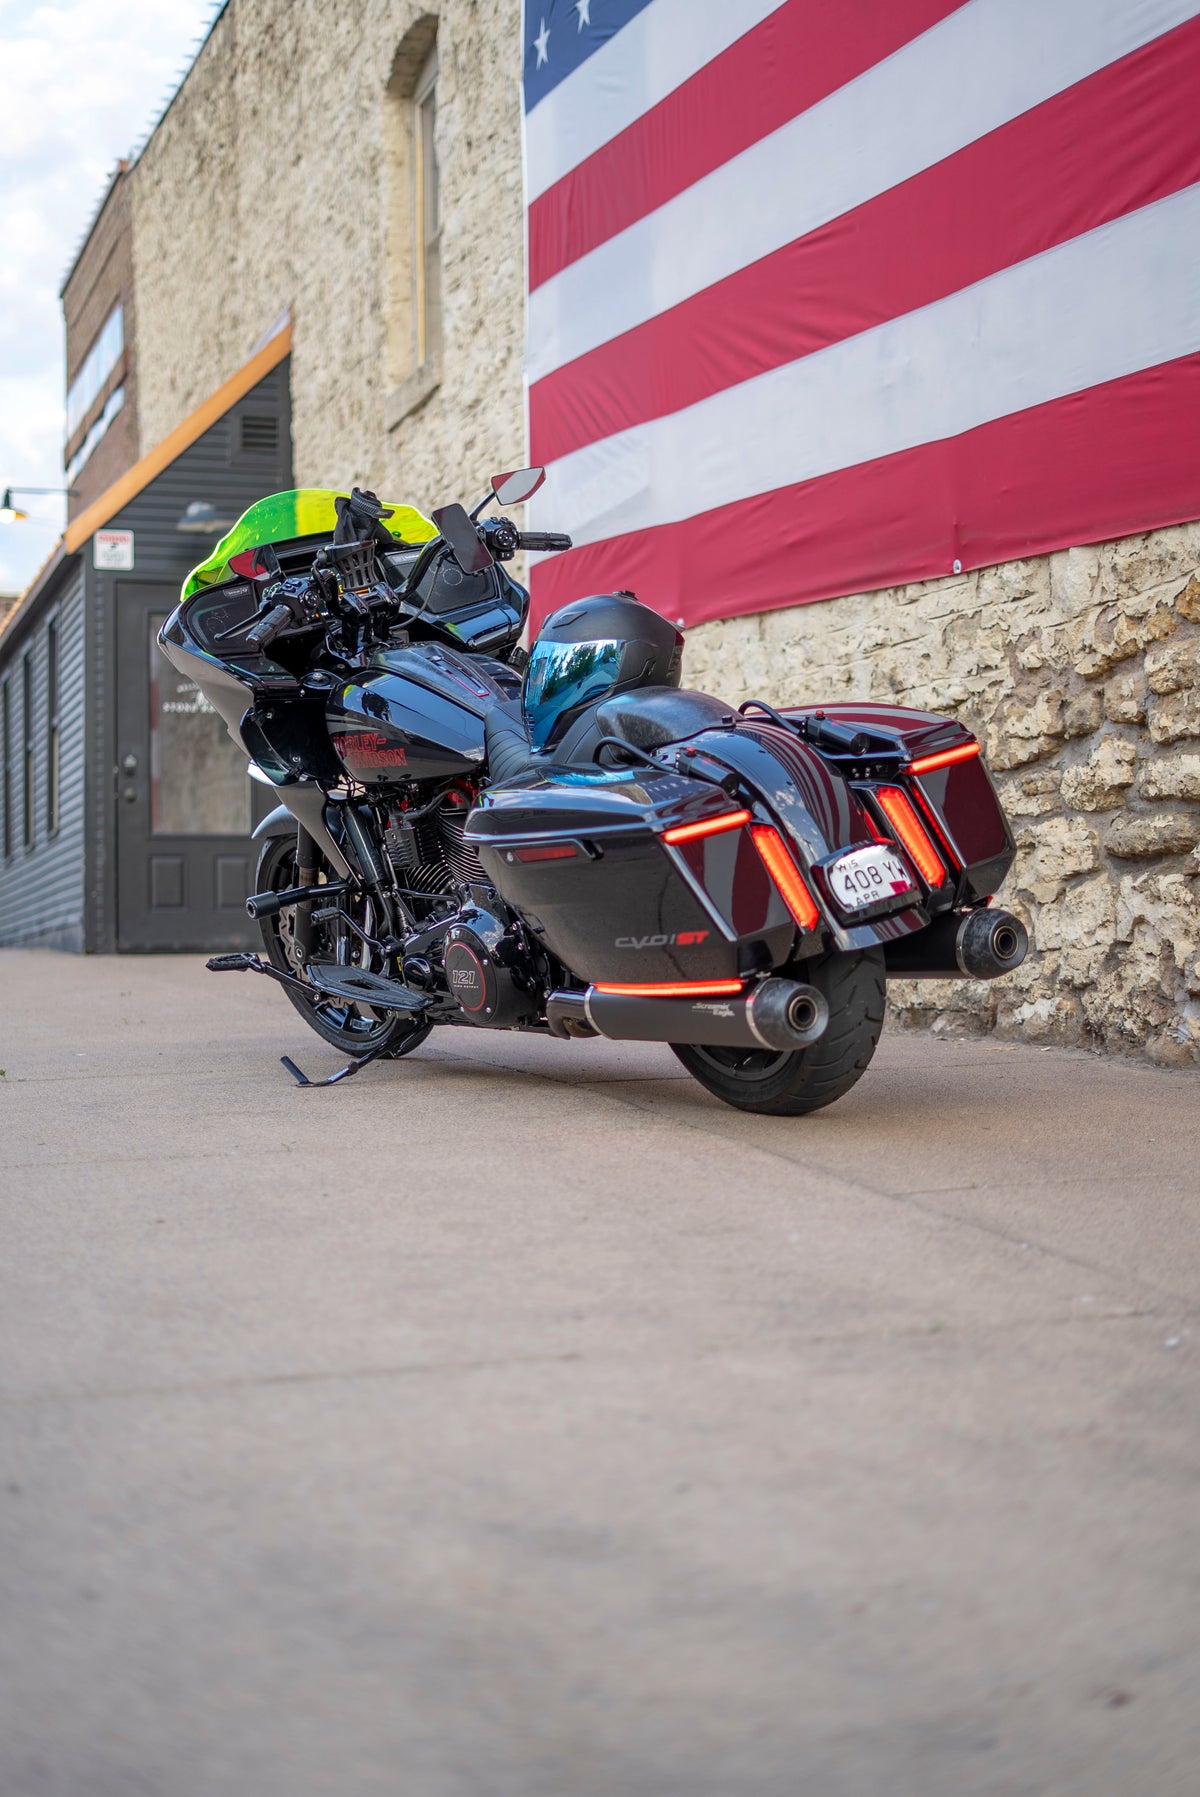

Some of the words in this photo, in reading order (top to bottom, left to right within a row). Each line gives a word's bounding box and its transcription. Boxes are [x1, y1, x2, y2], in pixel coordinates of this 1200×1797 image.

[835, 859, 859, 872] WIS
[844, 865, 882, 892] 408
[856, 890, 880, 905] APR
[452, 970, 475, 985] 121
